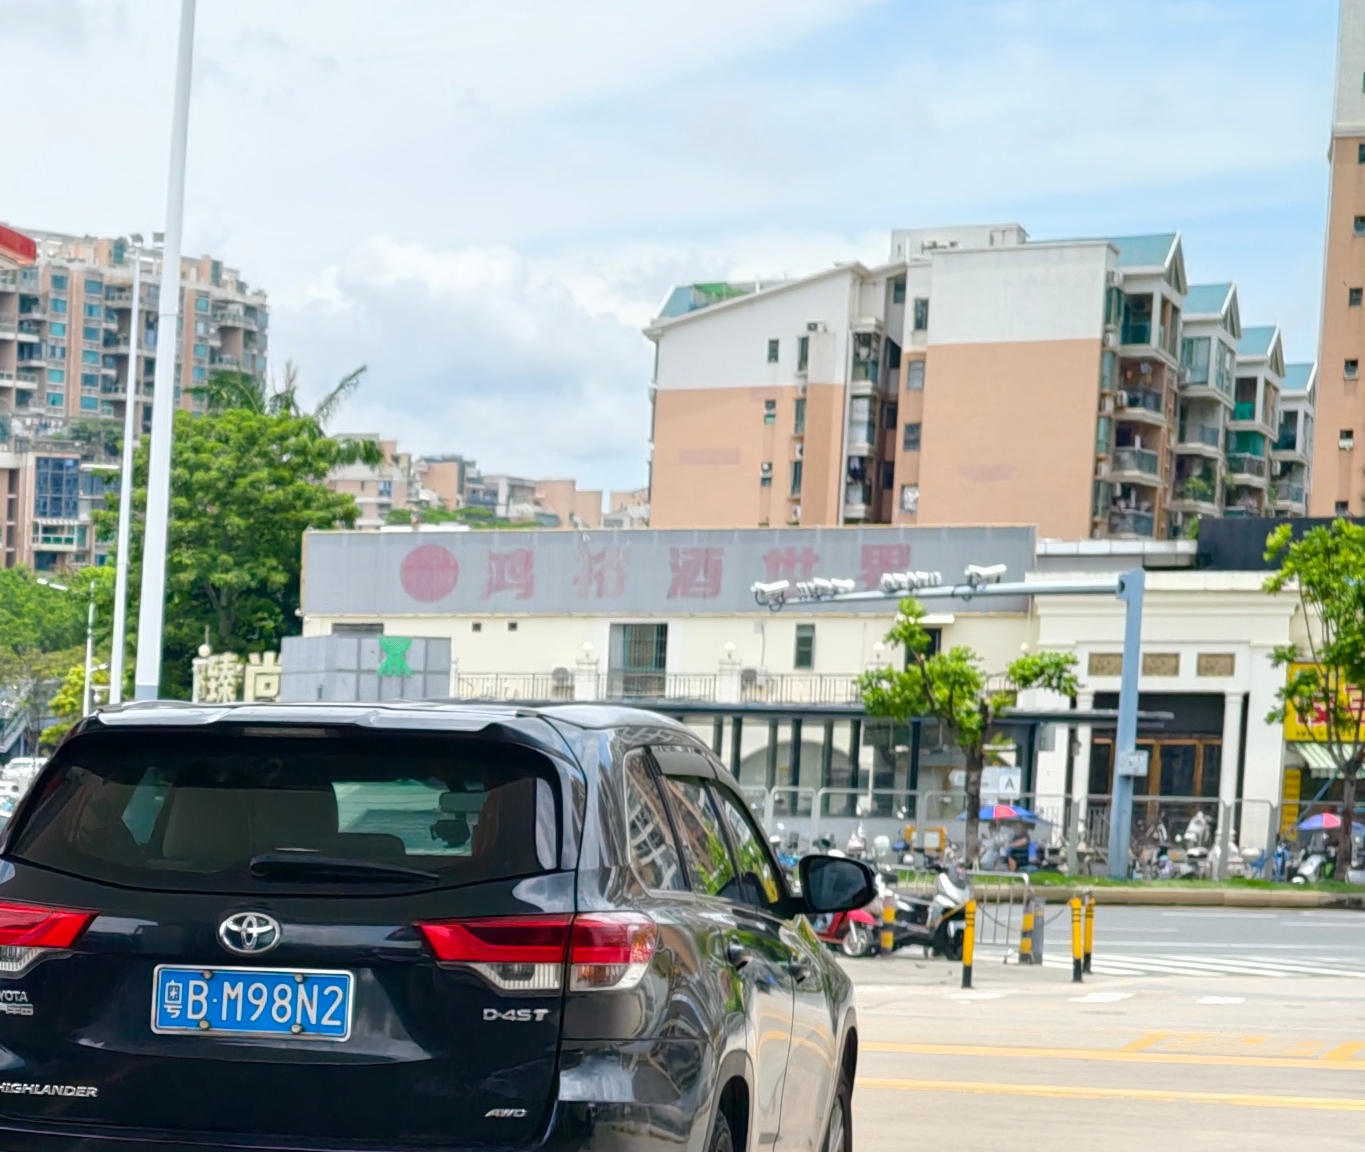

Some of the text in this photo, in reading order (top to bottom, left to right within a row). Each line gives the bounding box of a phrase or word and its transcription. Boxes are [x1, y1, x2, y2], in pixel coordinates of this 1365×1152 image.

[1004, 777, 1014, 790] A
[163, 979, 344, 1026] 粤B·M98N2
[485, 1108, 528, 1118] AWD
